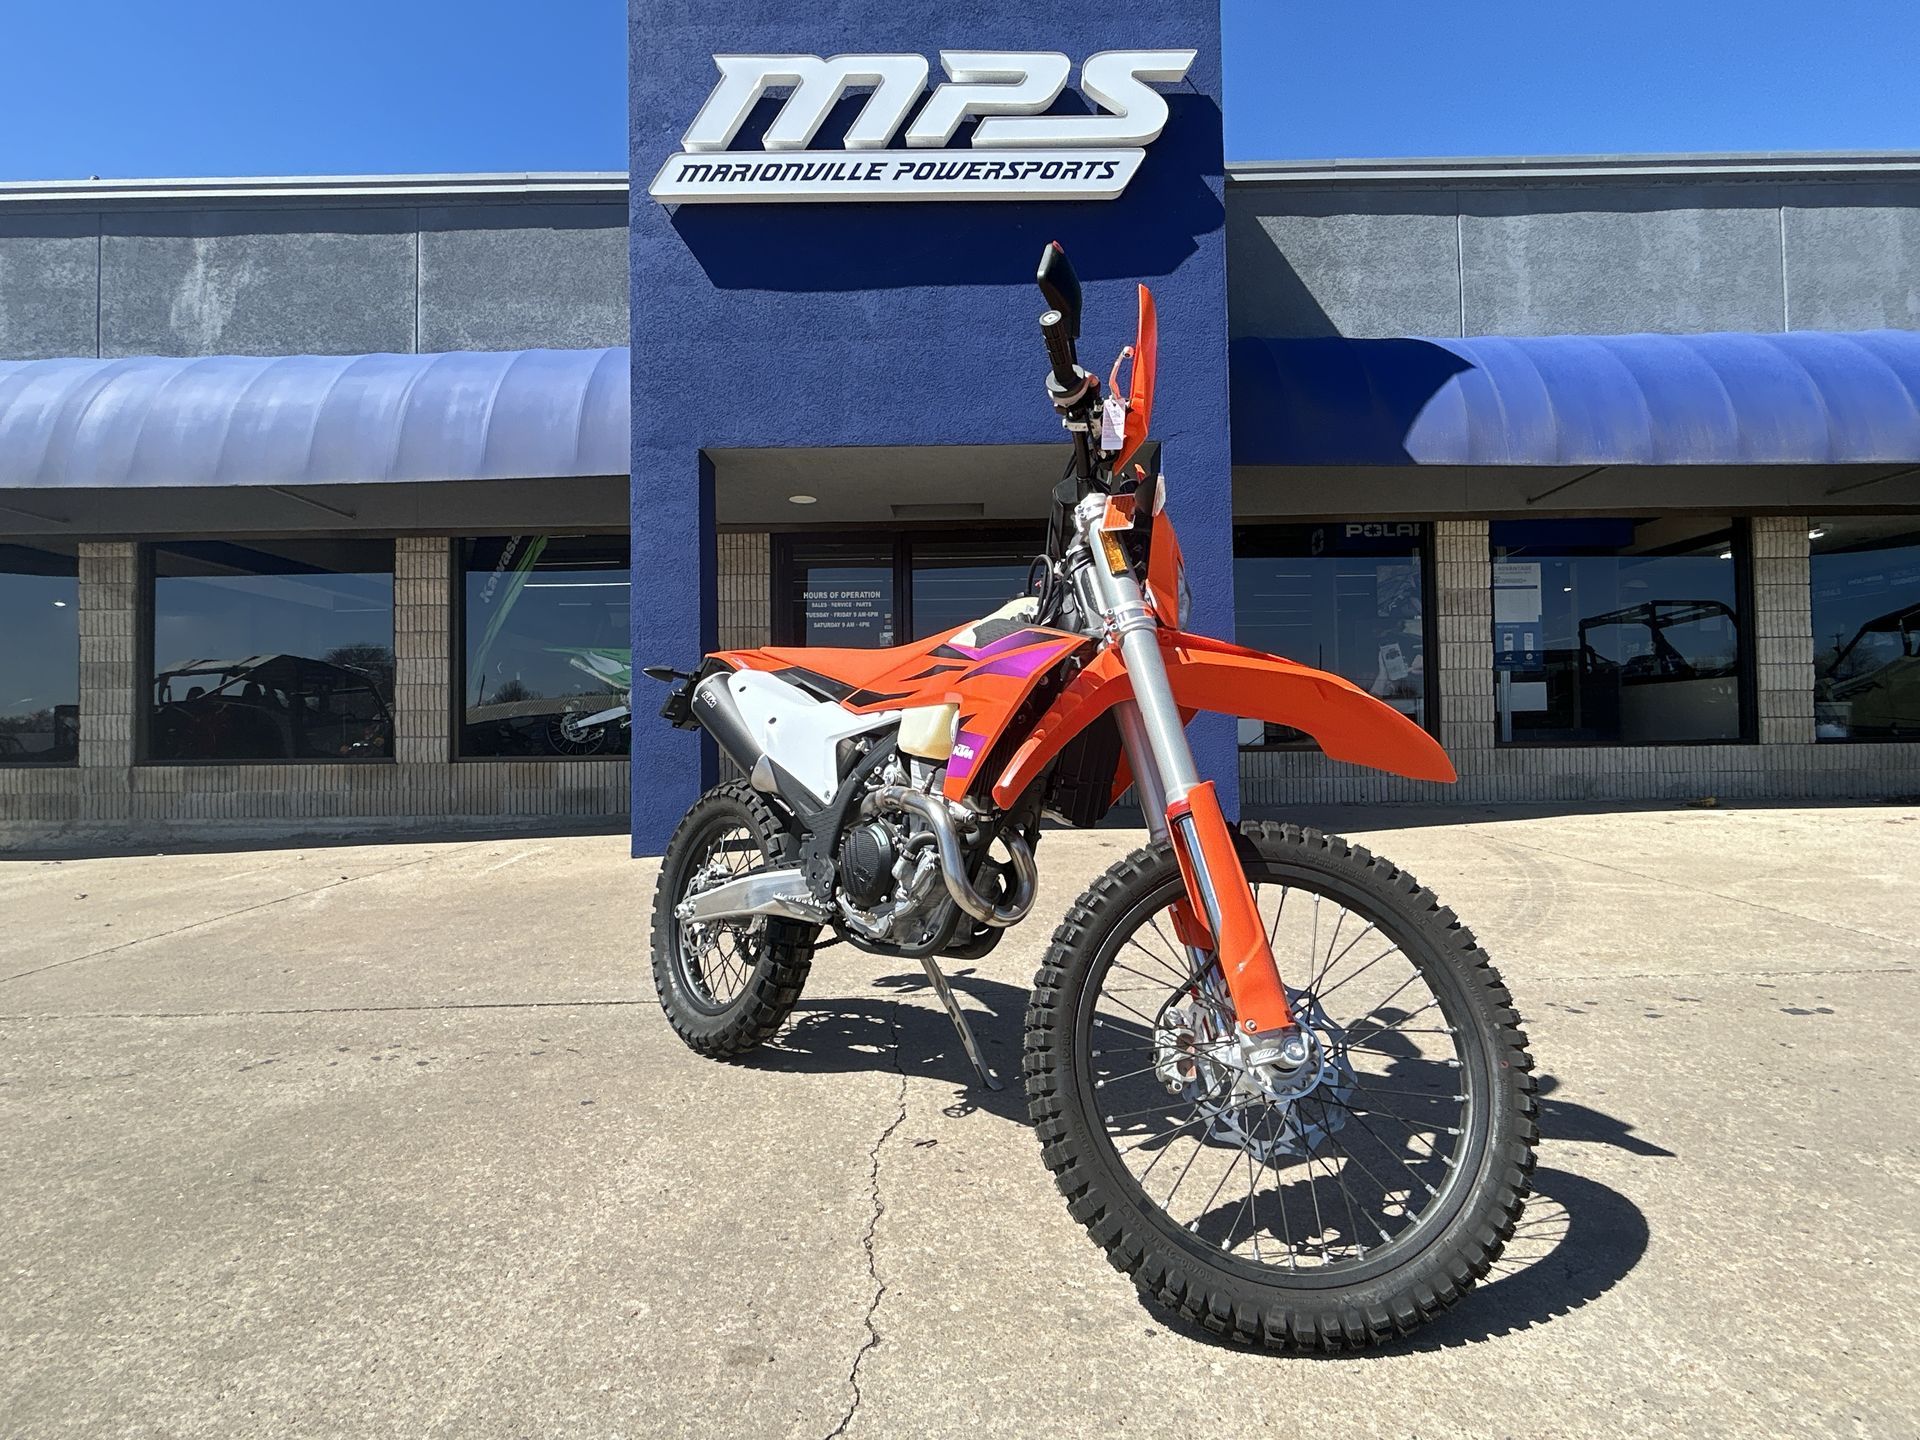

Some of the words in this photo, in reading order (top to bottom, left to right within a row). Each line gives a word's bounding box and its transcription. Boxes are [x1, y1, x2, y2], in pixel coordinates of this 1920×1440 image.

[683, 48, 1198, 150] MPS
[676, 162, 889, 183] MARIONVILLE
[892, 160, 1121, 181] POWERSPORTS
[803, 591, 828, 599] HOURS
[829, 591, 839, 599] OF
[840, 591, 881, 599] OPERATION
[702, 691, 717, 708] KTM
[952, 743, 975, 760] KTM
